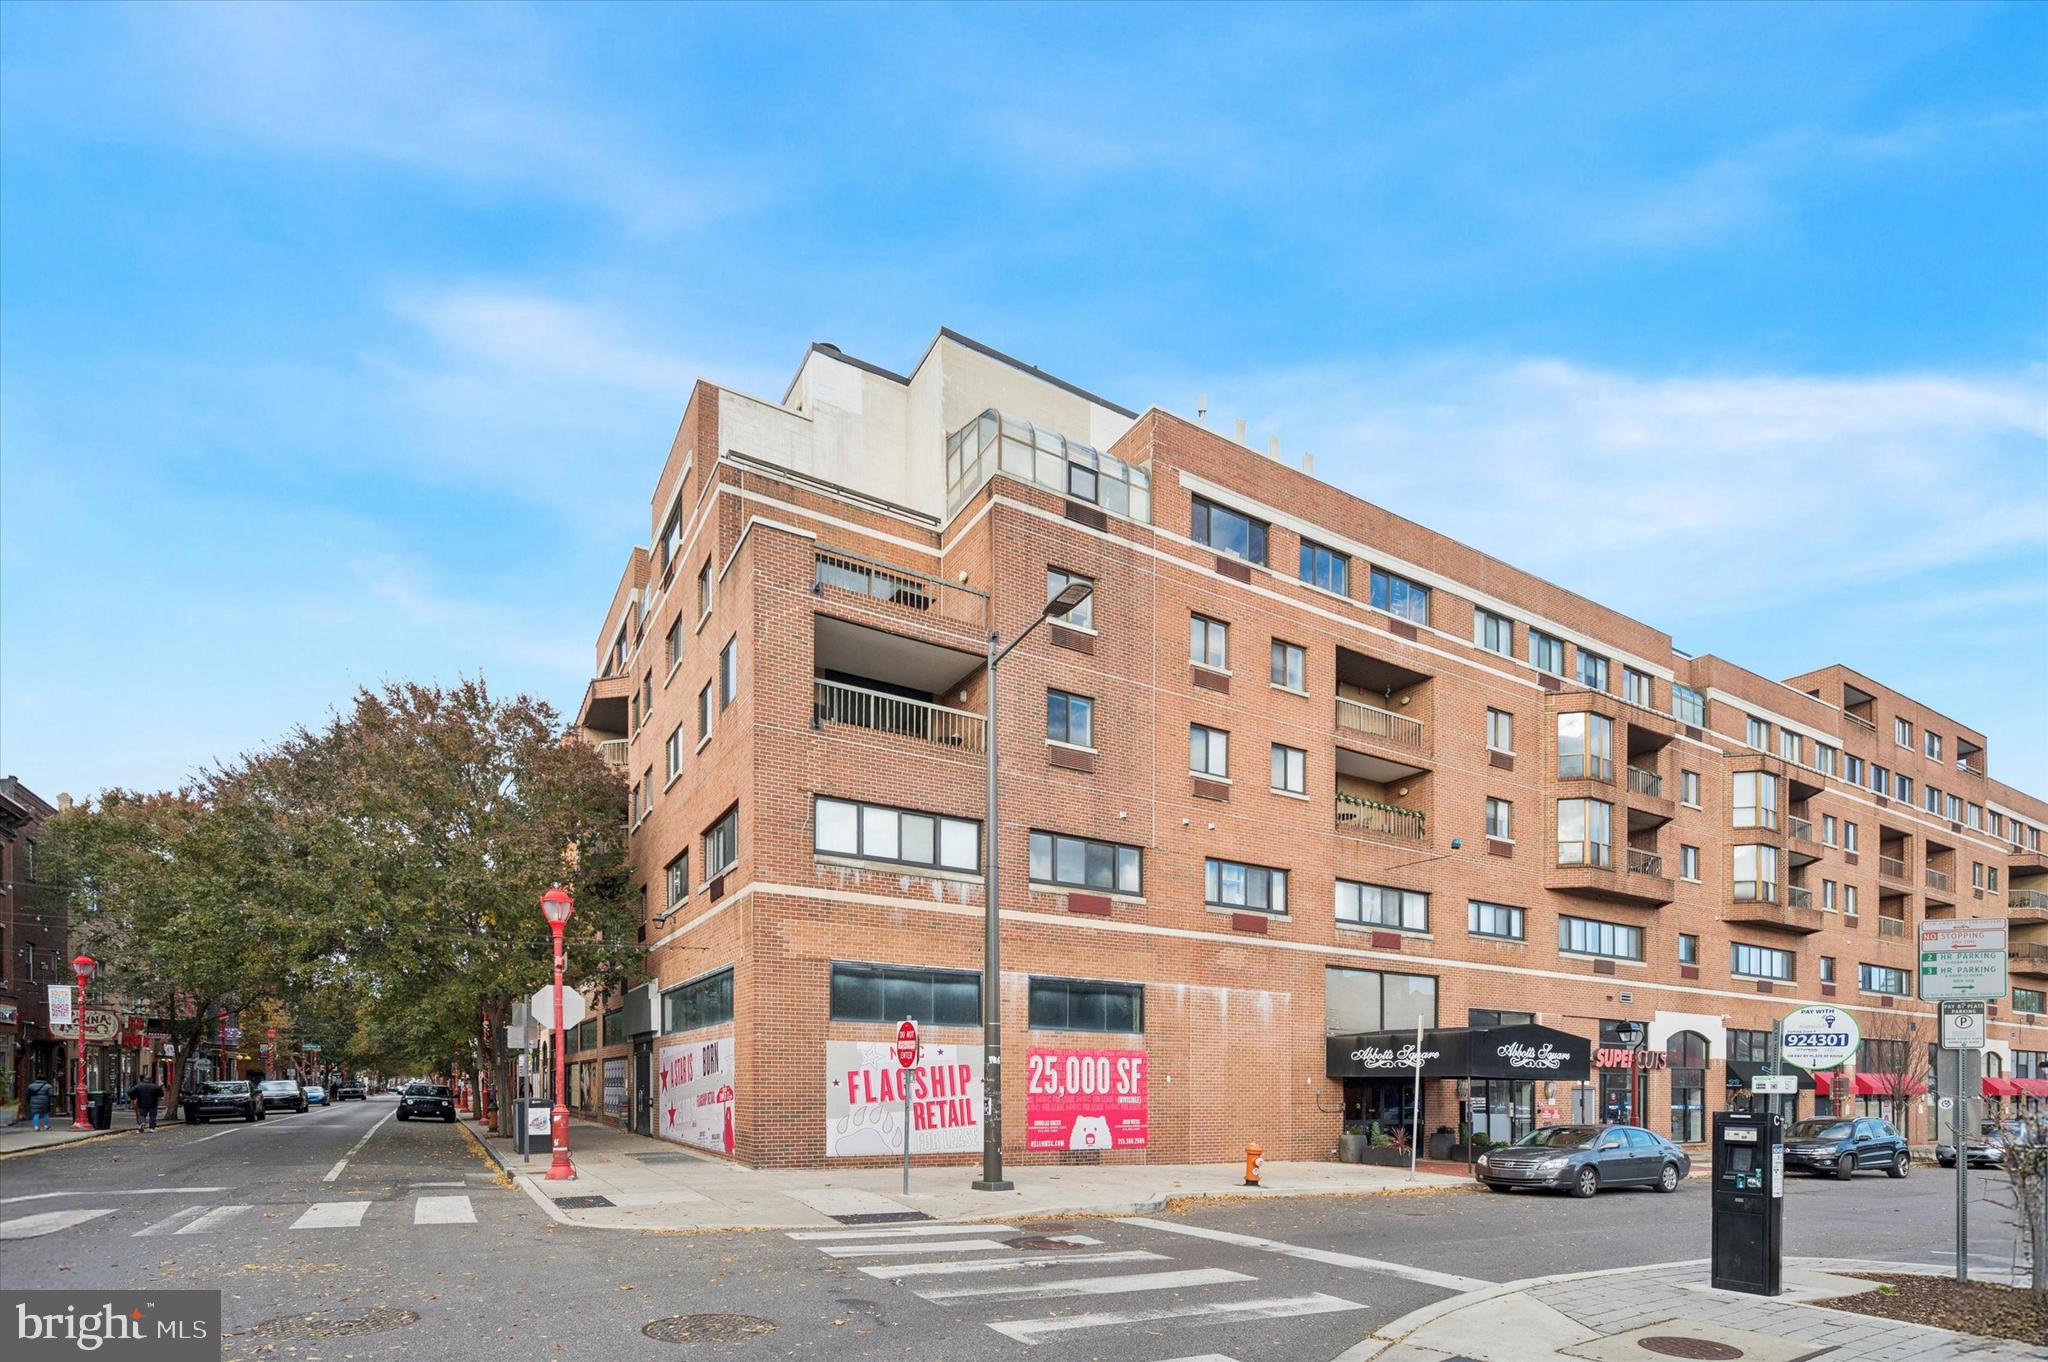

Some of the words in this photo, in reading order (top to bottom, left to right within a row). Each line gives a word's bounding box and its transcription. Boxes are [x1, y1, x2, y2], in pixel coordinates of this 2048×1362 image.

[1940, 932, 1985, 940] STOPPING
[1957, 952, 1997, 960] PARKING
[1927, 967, 1933, 975] 3
[906, 1030, 914, 1039] NOT
[1787, 1034, 1846, 1046] 924301
[900, 1051, 913, 1059] ENTER
[1537, 1043, 1570, 1062] Square
[675, 1056, 686, 1087] STAR
[688, 1052, 694, 1082] IS
[702, 1041, 719, 1077] BORN
[1029, 1054, 1110, 1098] 25,000
[1116, 1056, 1142, 1094] SF
[847, 1064, 972, 1105] FLAGSHIP
[913, 1098, 977, 1131] RETAIL
[916, 1132, 941, 1152] FOR
[943, 1129, 978, 1150] LEASE
